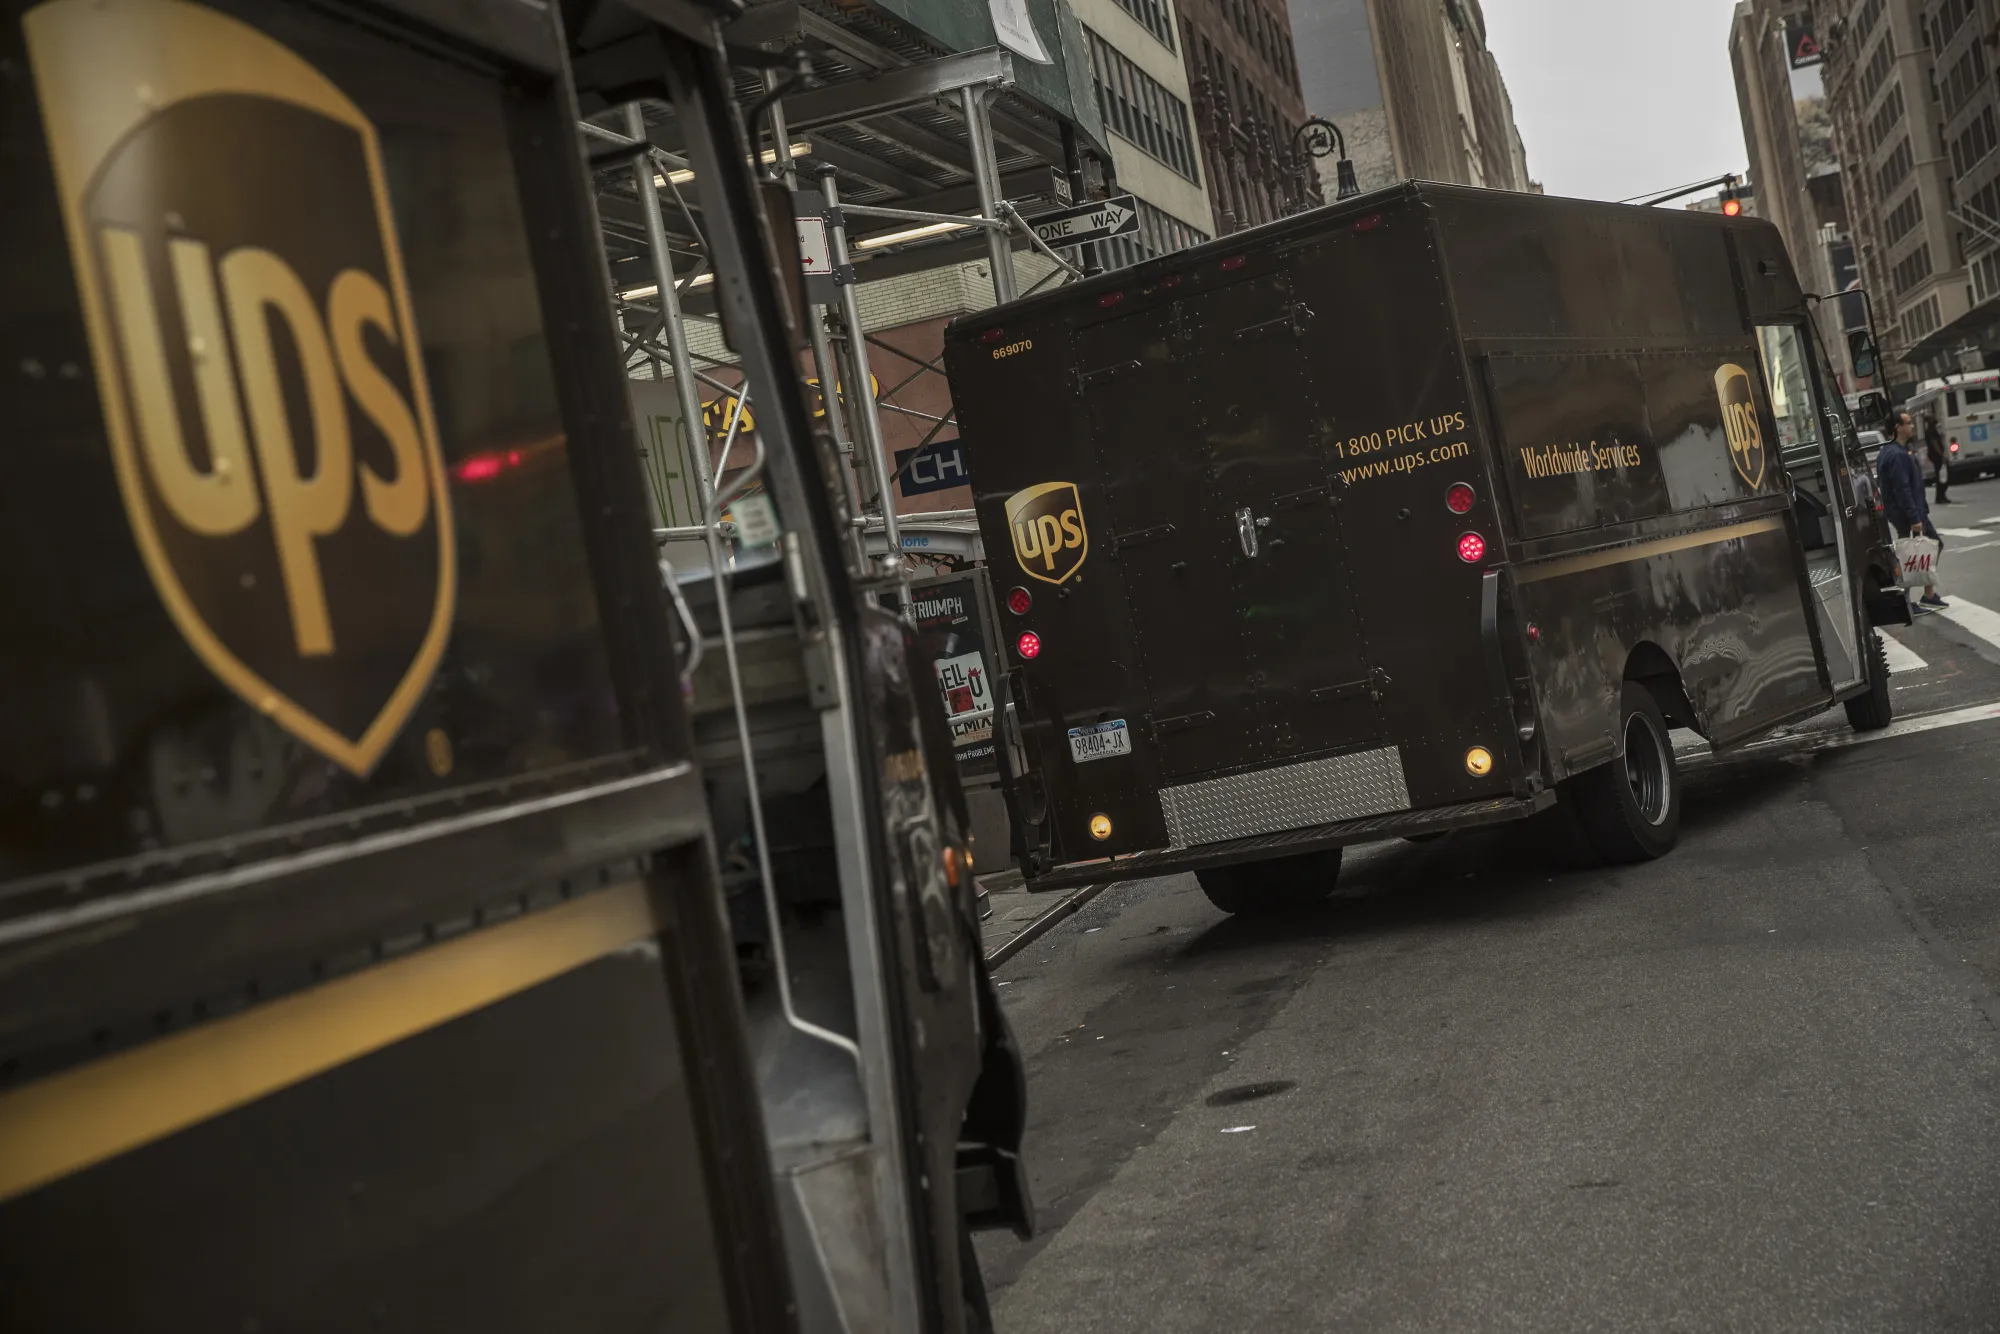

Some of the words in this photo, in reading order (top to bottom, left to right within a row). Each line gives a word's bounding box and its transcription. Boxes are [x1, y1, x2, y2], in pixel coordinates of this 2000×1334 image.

[1038, 221, 1074, 240] ONE
[1090, 208, 1124, 228] WAY
[992, 339, 1033, 360] 669070
[99, 225, 432, 658] ups
[1335, 441, 1344, 459] 1
[1348, 432, 1382, 456] 800
[1386, 420, 1427, 447] PICK
[1430, 411, 1465, 436] UPS
[1722, 401, 1761, 471] ups
[910, 449, 968, 485] CH
[1341, 440, 1470, 484] www.ups.com
[1520, 442, 1591, 480] Worldwide
[1590, 438, 1642, 471] Services
[1014, 509, 1083, 572] ups
[1903, 553, 1932, 573] H&M
